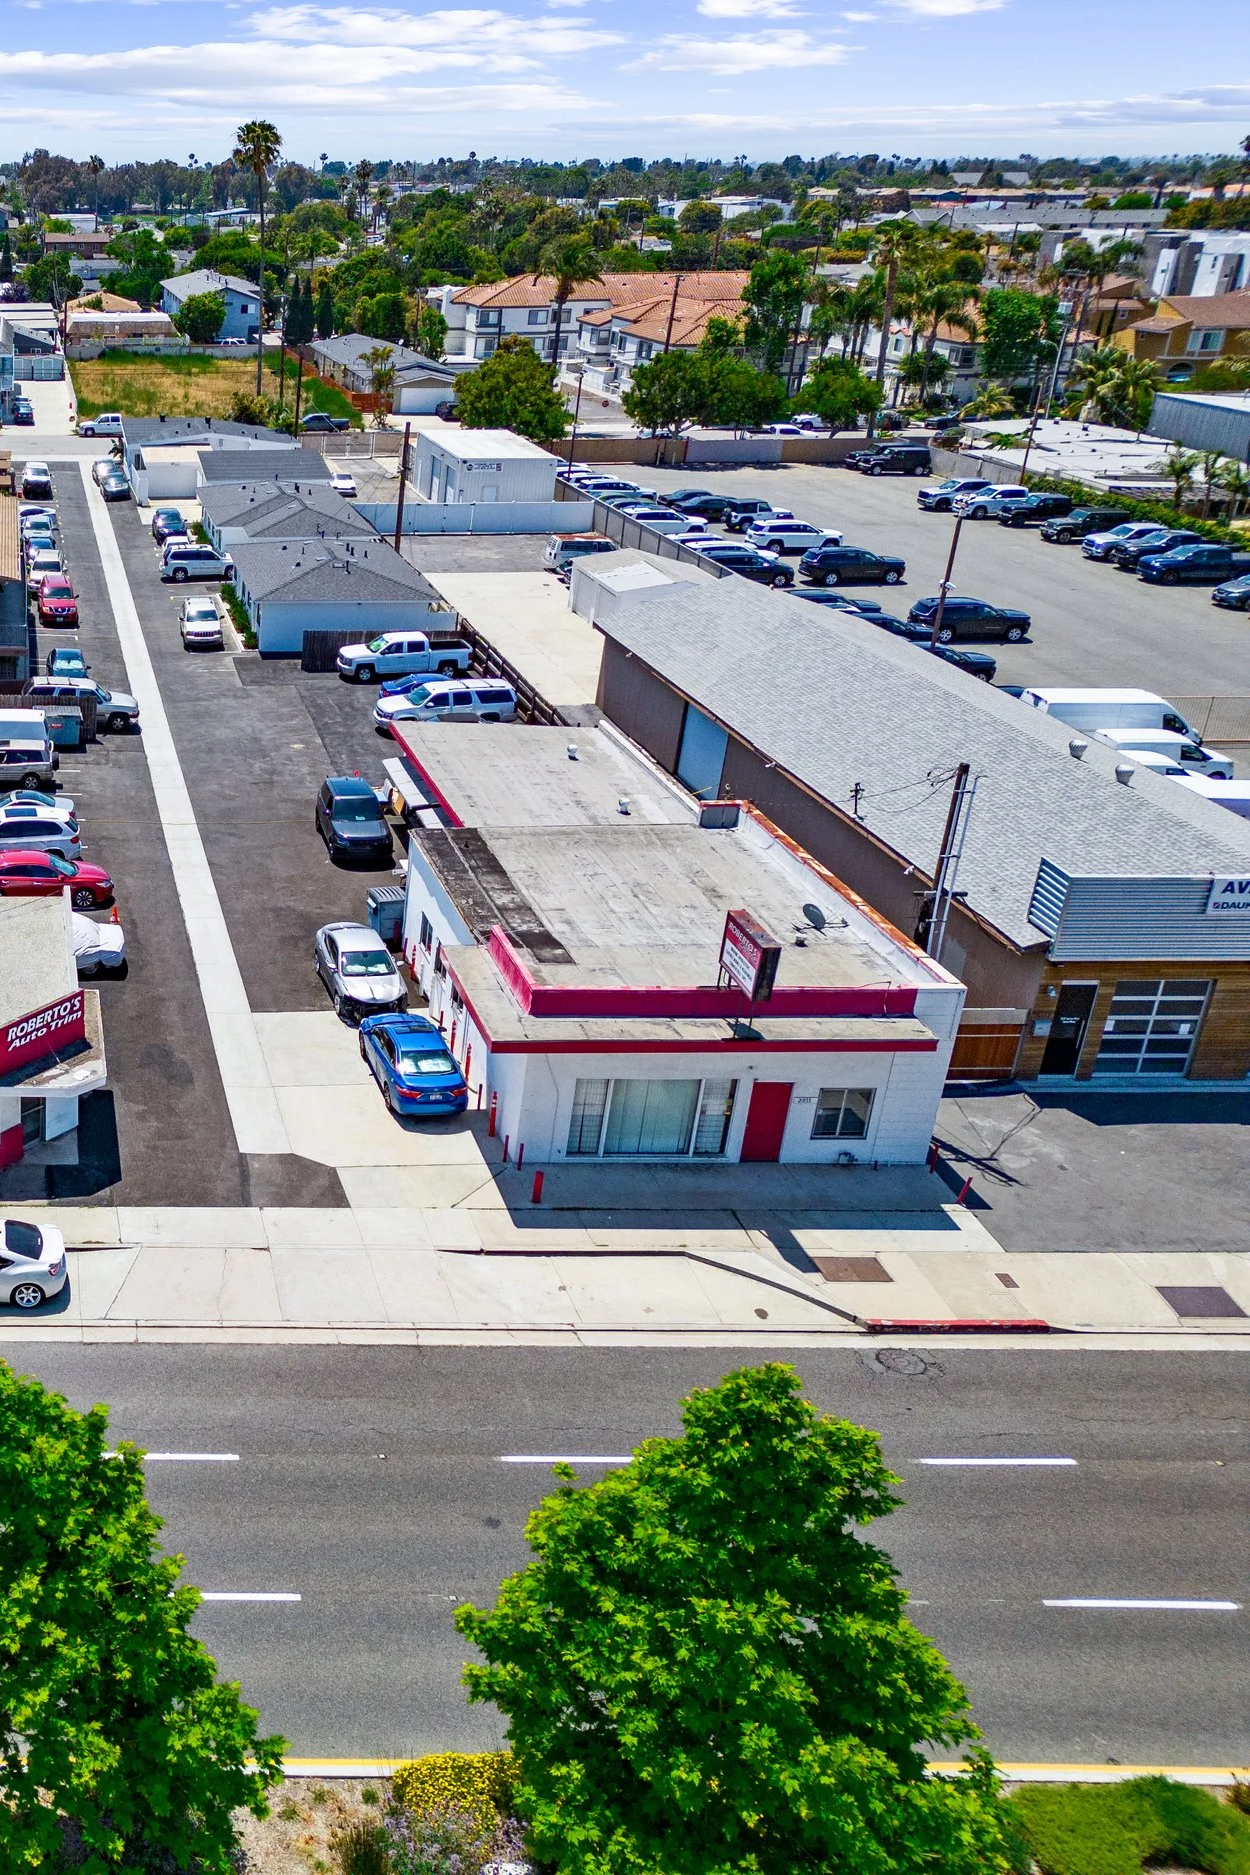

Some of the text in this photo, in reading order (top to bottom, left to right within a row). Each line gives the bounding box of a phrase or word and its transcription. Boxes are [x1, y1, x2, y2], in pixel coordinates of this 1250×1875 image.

[1221, 881, 1250, 894] AV
[7, 996, 82, 1042] ROBERTO'S
[7, 1011, 82, 1052] Auto Trim
